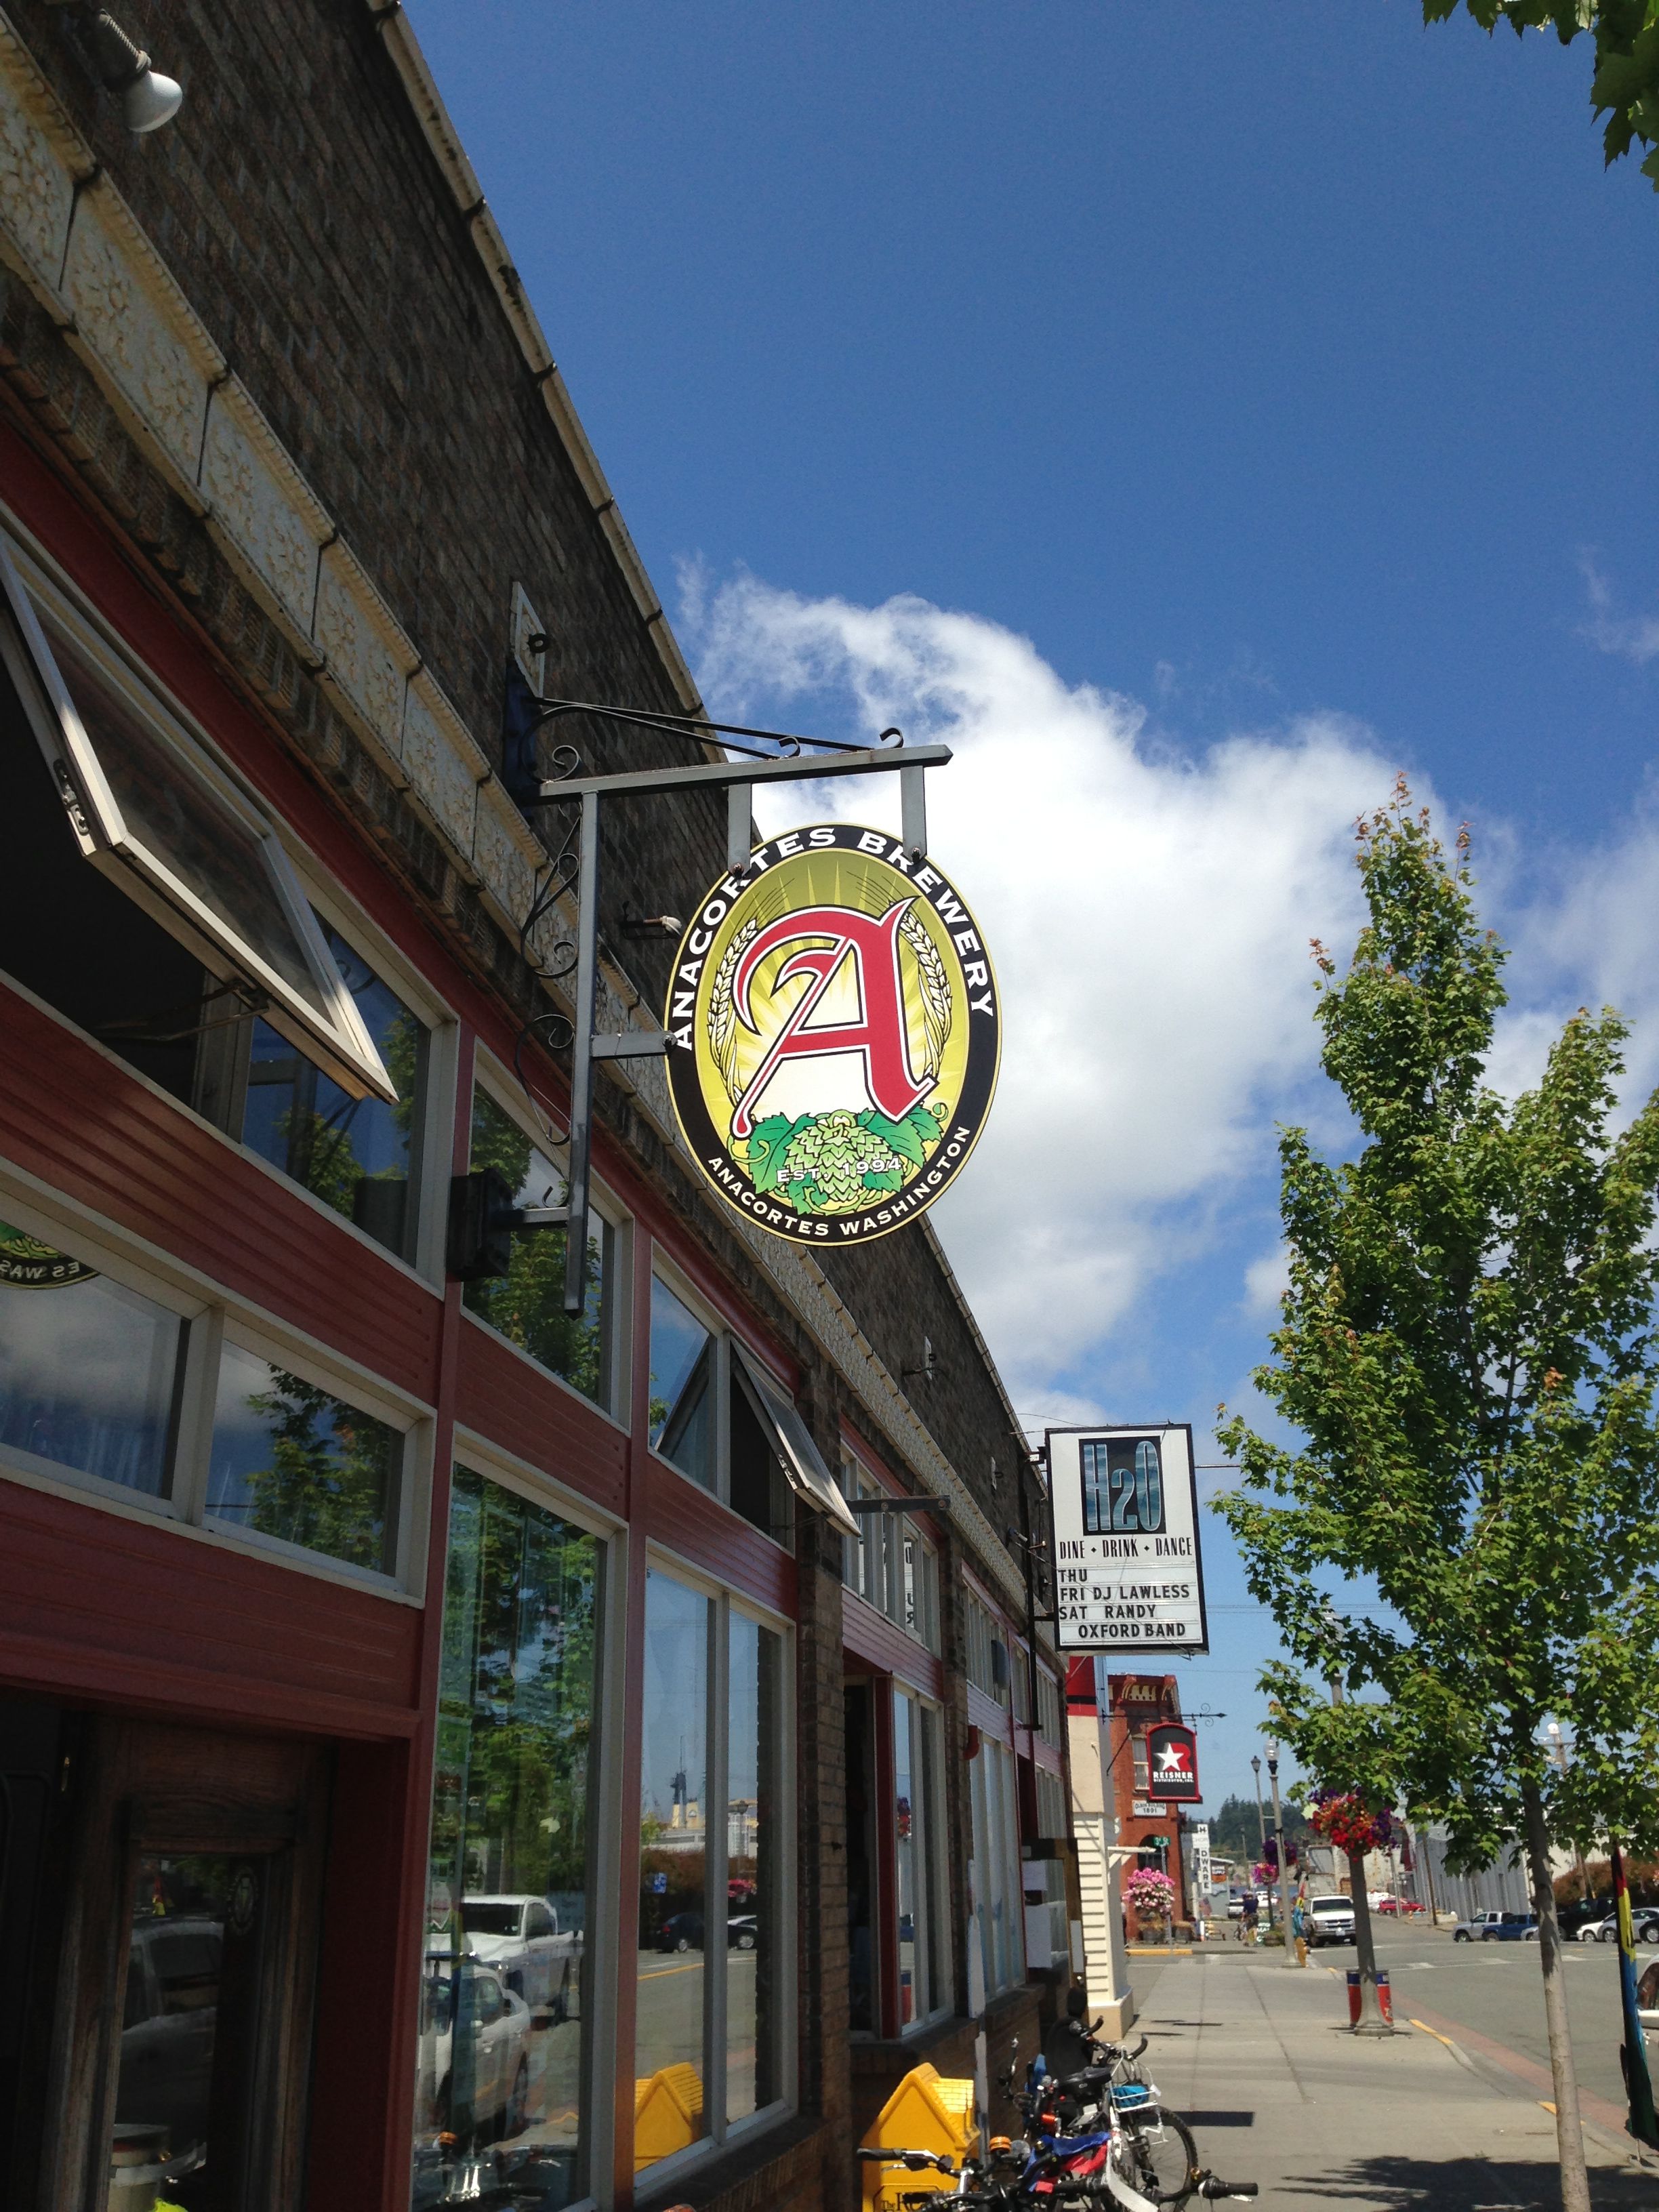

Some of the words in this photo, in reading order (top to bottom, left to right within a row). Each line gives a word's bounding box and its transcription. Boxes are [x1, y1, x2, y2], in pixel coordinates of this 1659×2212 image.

[672, 827, 837, 1051] ANACORTES
[857, 830, 994, 1017] BREWERY
[842, 1157, 902, 1176] 1994
[708, 1156, 829, 1237] ANACORTES
[840, 1126, 971, 1236] WASHINGTON
[1083, 1440, 1162, 1532] H2O
[1059, 1540, 1085, 1559] DINE
[1102, 1538, 1139, 1558] DRINK
[1155, 1537, 1193, 1557] DANCE
[1059, 1569, 1088, 1582] THU
[1060, 1587, 1085, 1601] FRI
[1093, 1586, 1111, 1600] DJ
[1120, 1584, 1190, 1600] LAWLESS
[1059, 1606, 1088, 1620] SAT
[1105, 1604, 1156, 1619] RANDY
[1079, 1624, 1140, 1638] OXFORD
[1145, 1622, 1186, 1637] BAND
